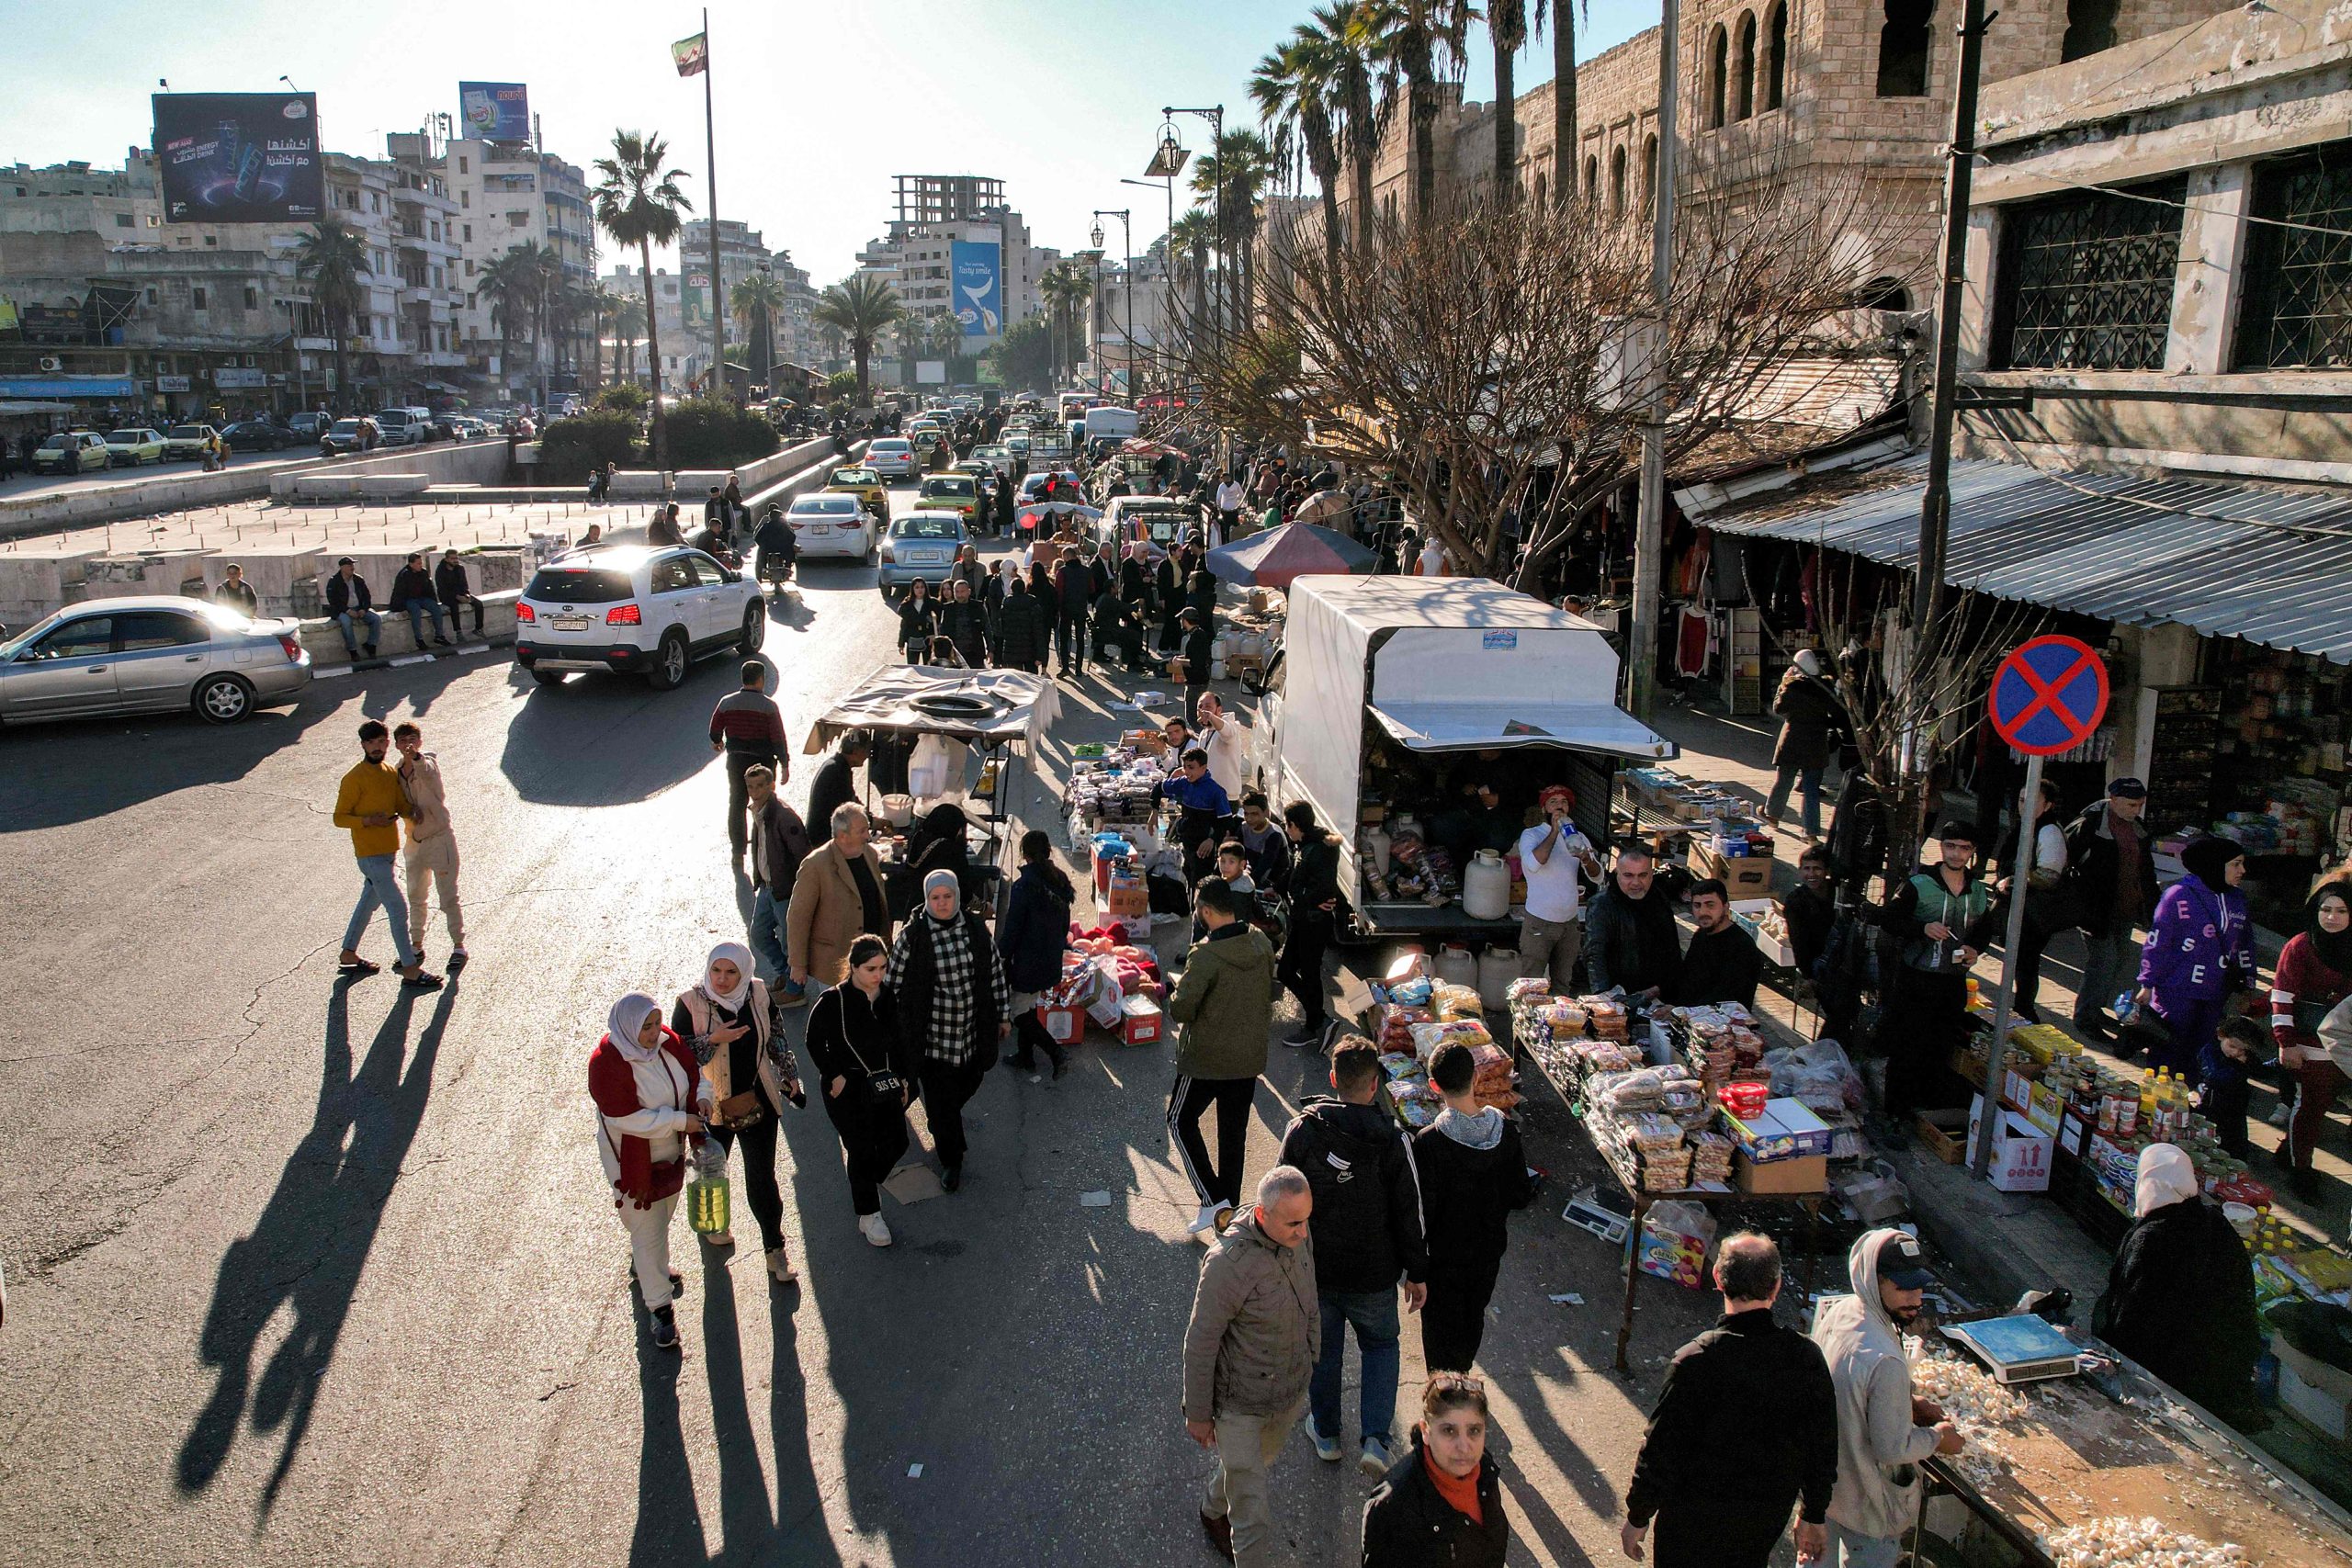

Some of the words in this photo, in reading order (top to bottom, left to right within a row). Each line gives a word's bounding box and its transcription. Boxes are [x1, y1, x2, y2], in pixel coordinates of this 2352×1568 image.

[196, 141, 219, 152] ENERGY
[197, 149, 215, 159] DRINK
[296, 157, 310, 166] مع
[958, 265, 974, 276] Tasty
[976, 266, 991, 275] smile
